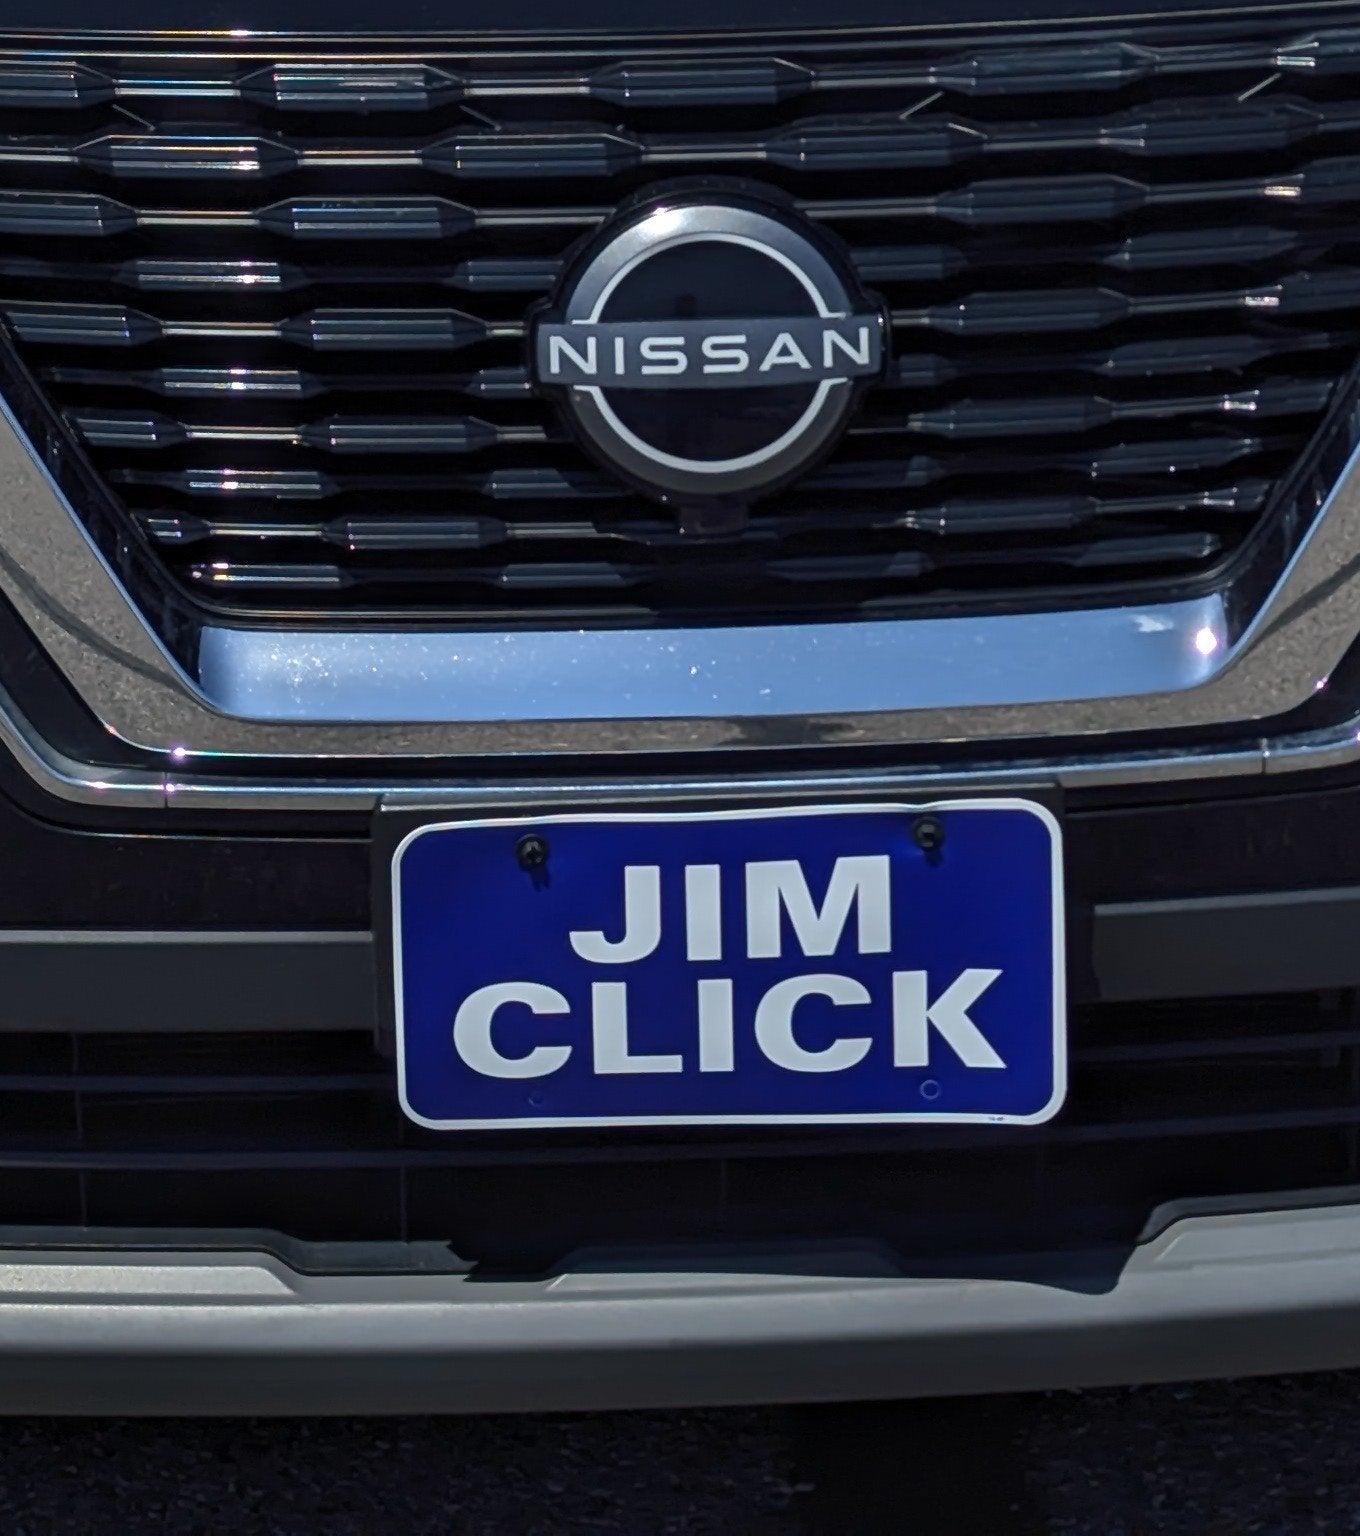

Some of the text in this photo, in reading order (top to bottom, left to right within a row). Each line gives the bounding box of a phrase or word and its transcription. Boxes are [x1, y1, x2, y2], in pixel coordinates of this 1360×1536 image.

[549, 326, 870, 375] NISSAN
[569, 855, 891, 963] JIM
[453, 968, 1007, 1078] CLICK
